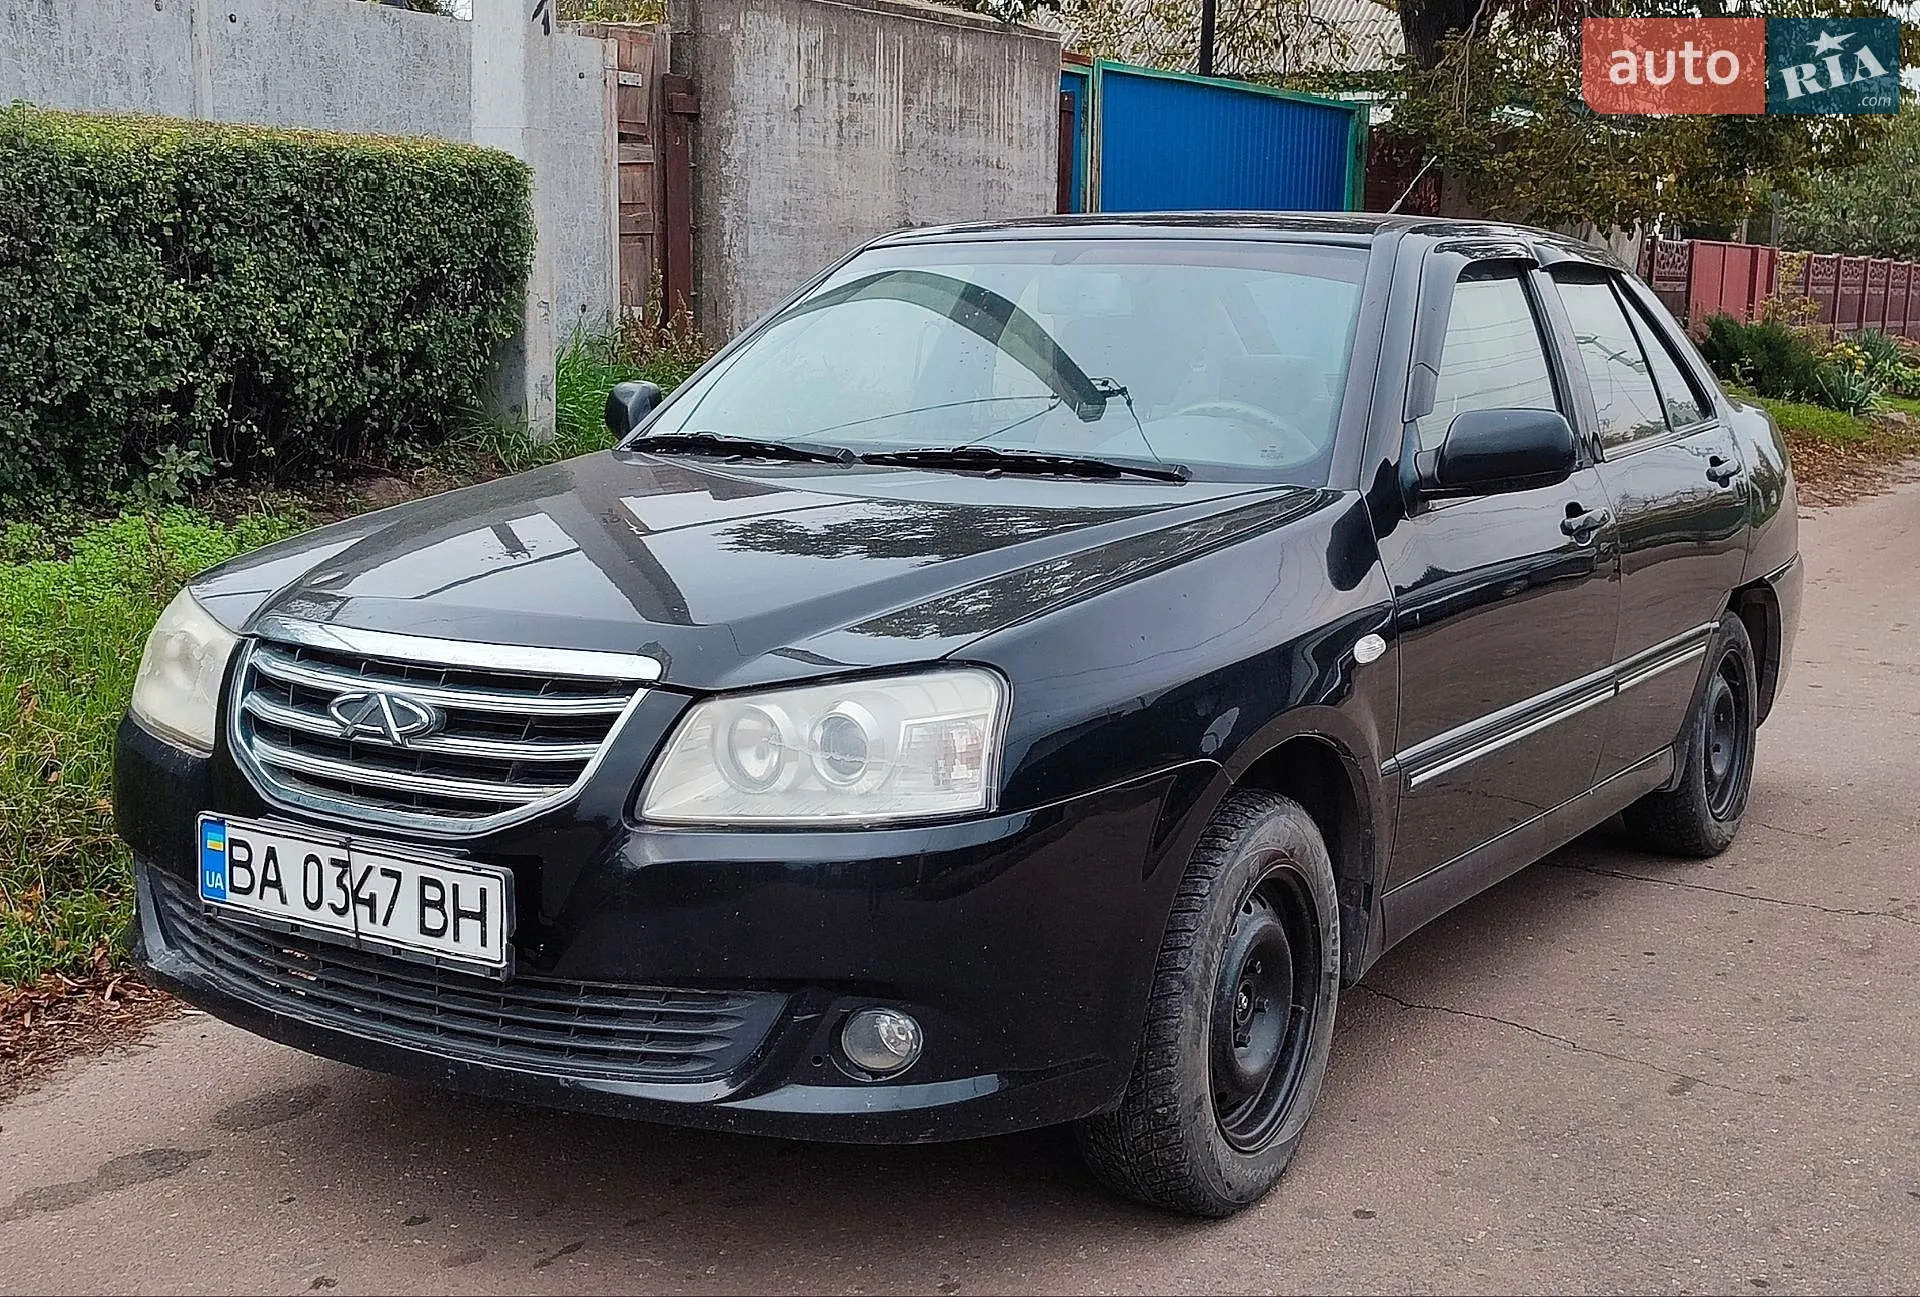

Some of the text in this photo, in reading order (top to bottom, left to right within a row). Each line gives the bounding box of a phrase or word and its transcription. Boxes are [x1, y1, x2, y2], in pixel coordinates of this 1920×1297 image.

[205, 870, 224, 890] UA
[228, 837, 487, 948] BA 0347 BH
